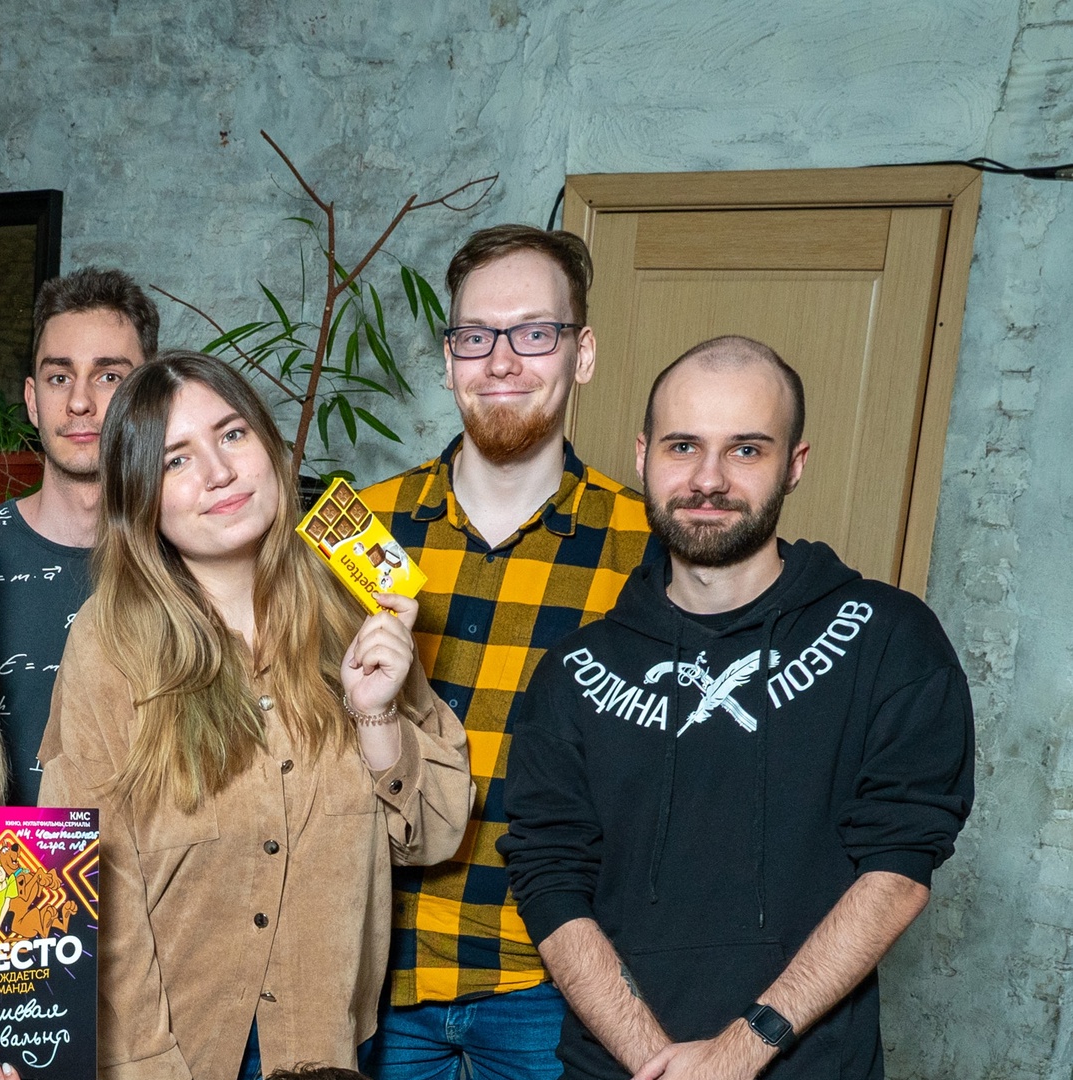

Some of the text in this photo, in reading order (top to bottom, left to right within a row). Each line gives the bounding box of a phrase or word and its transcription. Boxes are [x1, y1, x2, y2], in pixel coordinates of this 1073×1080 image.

[340, 554, 397, 615] ogetten
[562, 600, 873, 731] РОДИНА ПОЭТОВ
[69, 811, 91, 821] КМС
